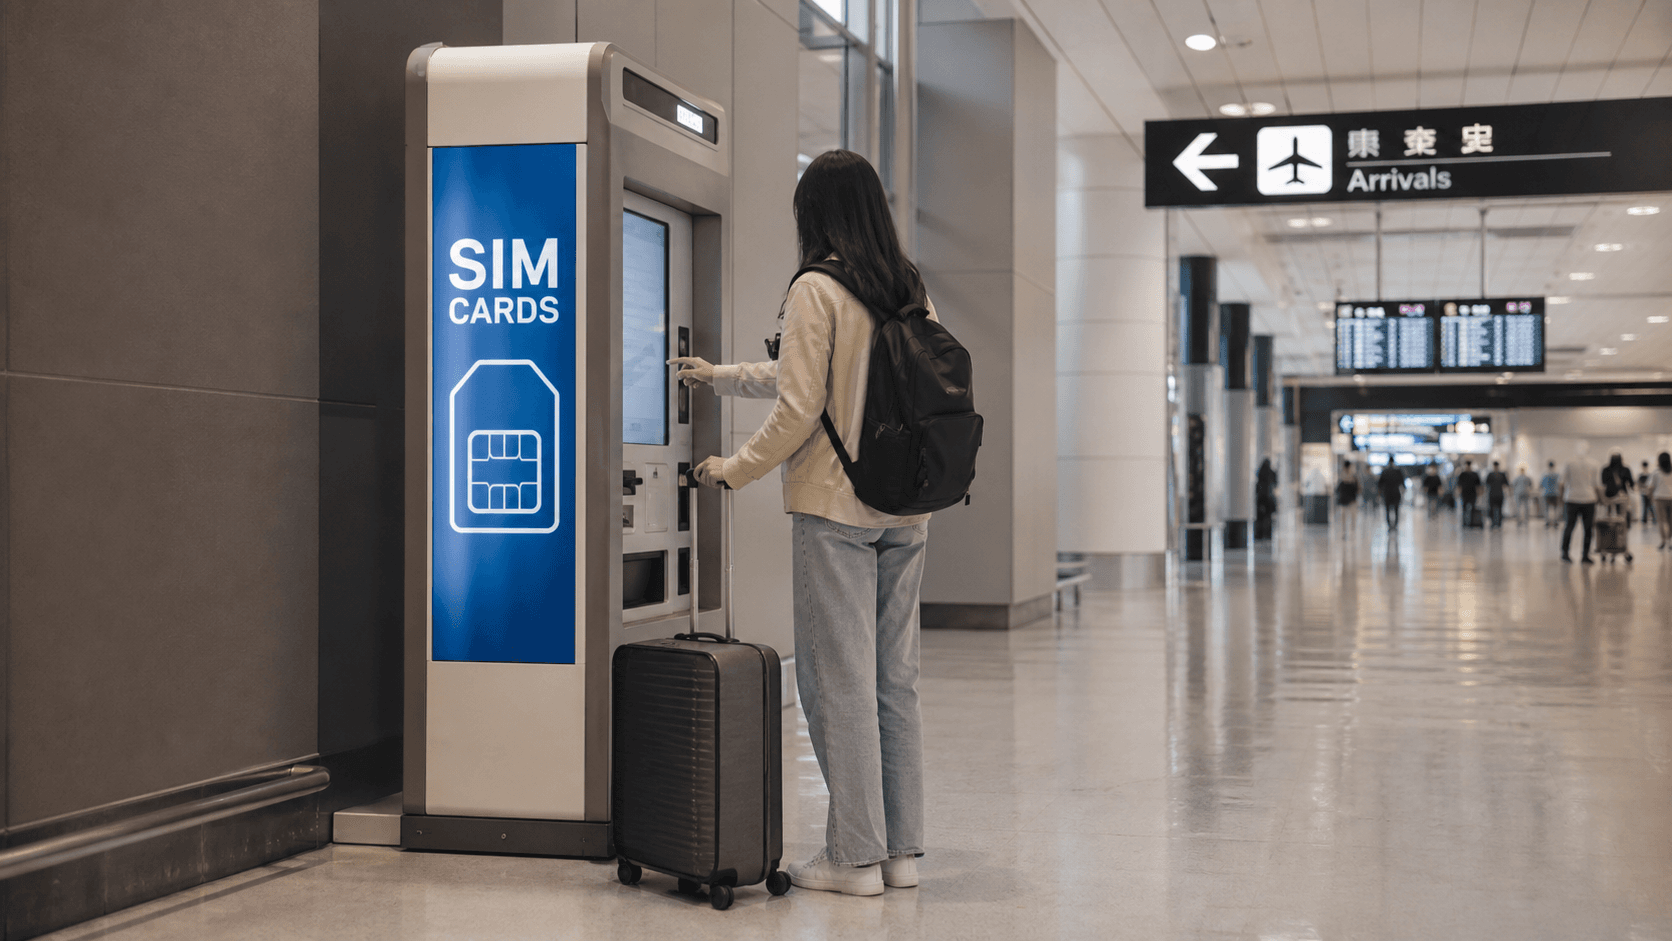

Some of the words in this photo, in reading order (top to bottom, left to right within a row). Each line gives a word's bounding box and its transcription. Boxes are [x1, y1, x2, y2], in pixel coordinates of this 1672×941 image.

[1347, 165, 1452, 193] Arrivals
[448, 237, 558, 290] SIM
[448, 295, 559, 325] CARDS
